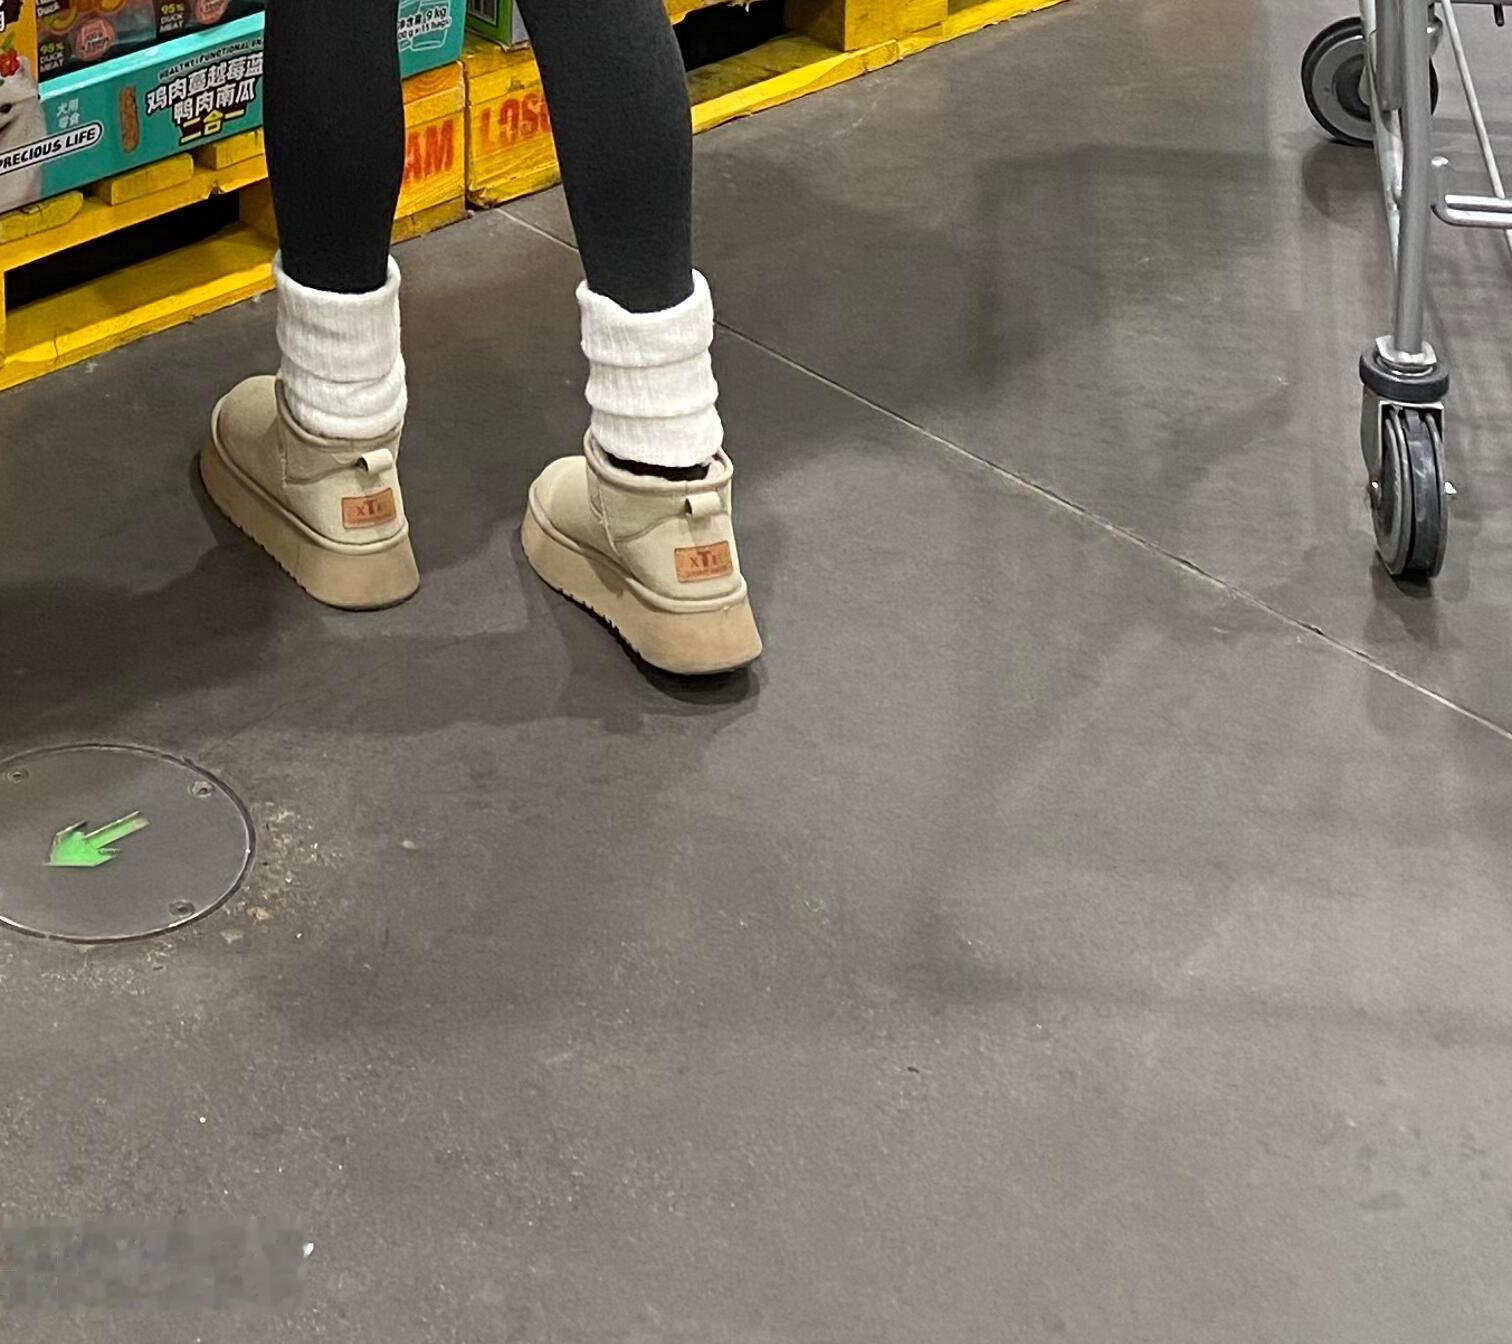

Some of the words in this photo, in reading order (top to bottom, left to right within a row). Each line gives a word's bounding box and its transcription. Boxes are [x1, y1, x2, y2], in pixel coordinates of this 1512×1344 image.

[173, 79, 255, 124] 鸭肉南瓜
[66, 127, 97, 148] LIFE
[180, 109, 245, 145] 二合一
